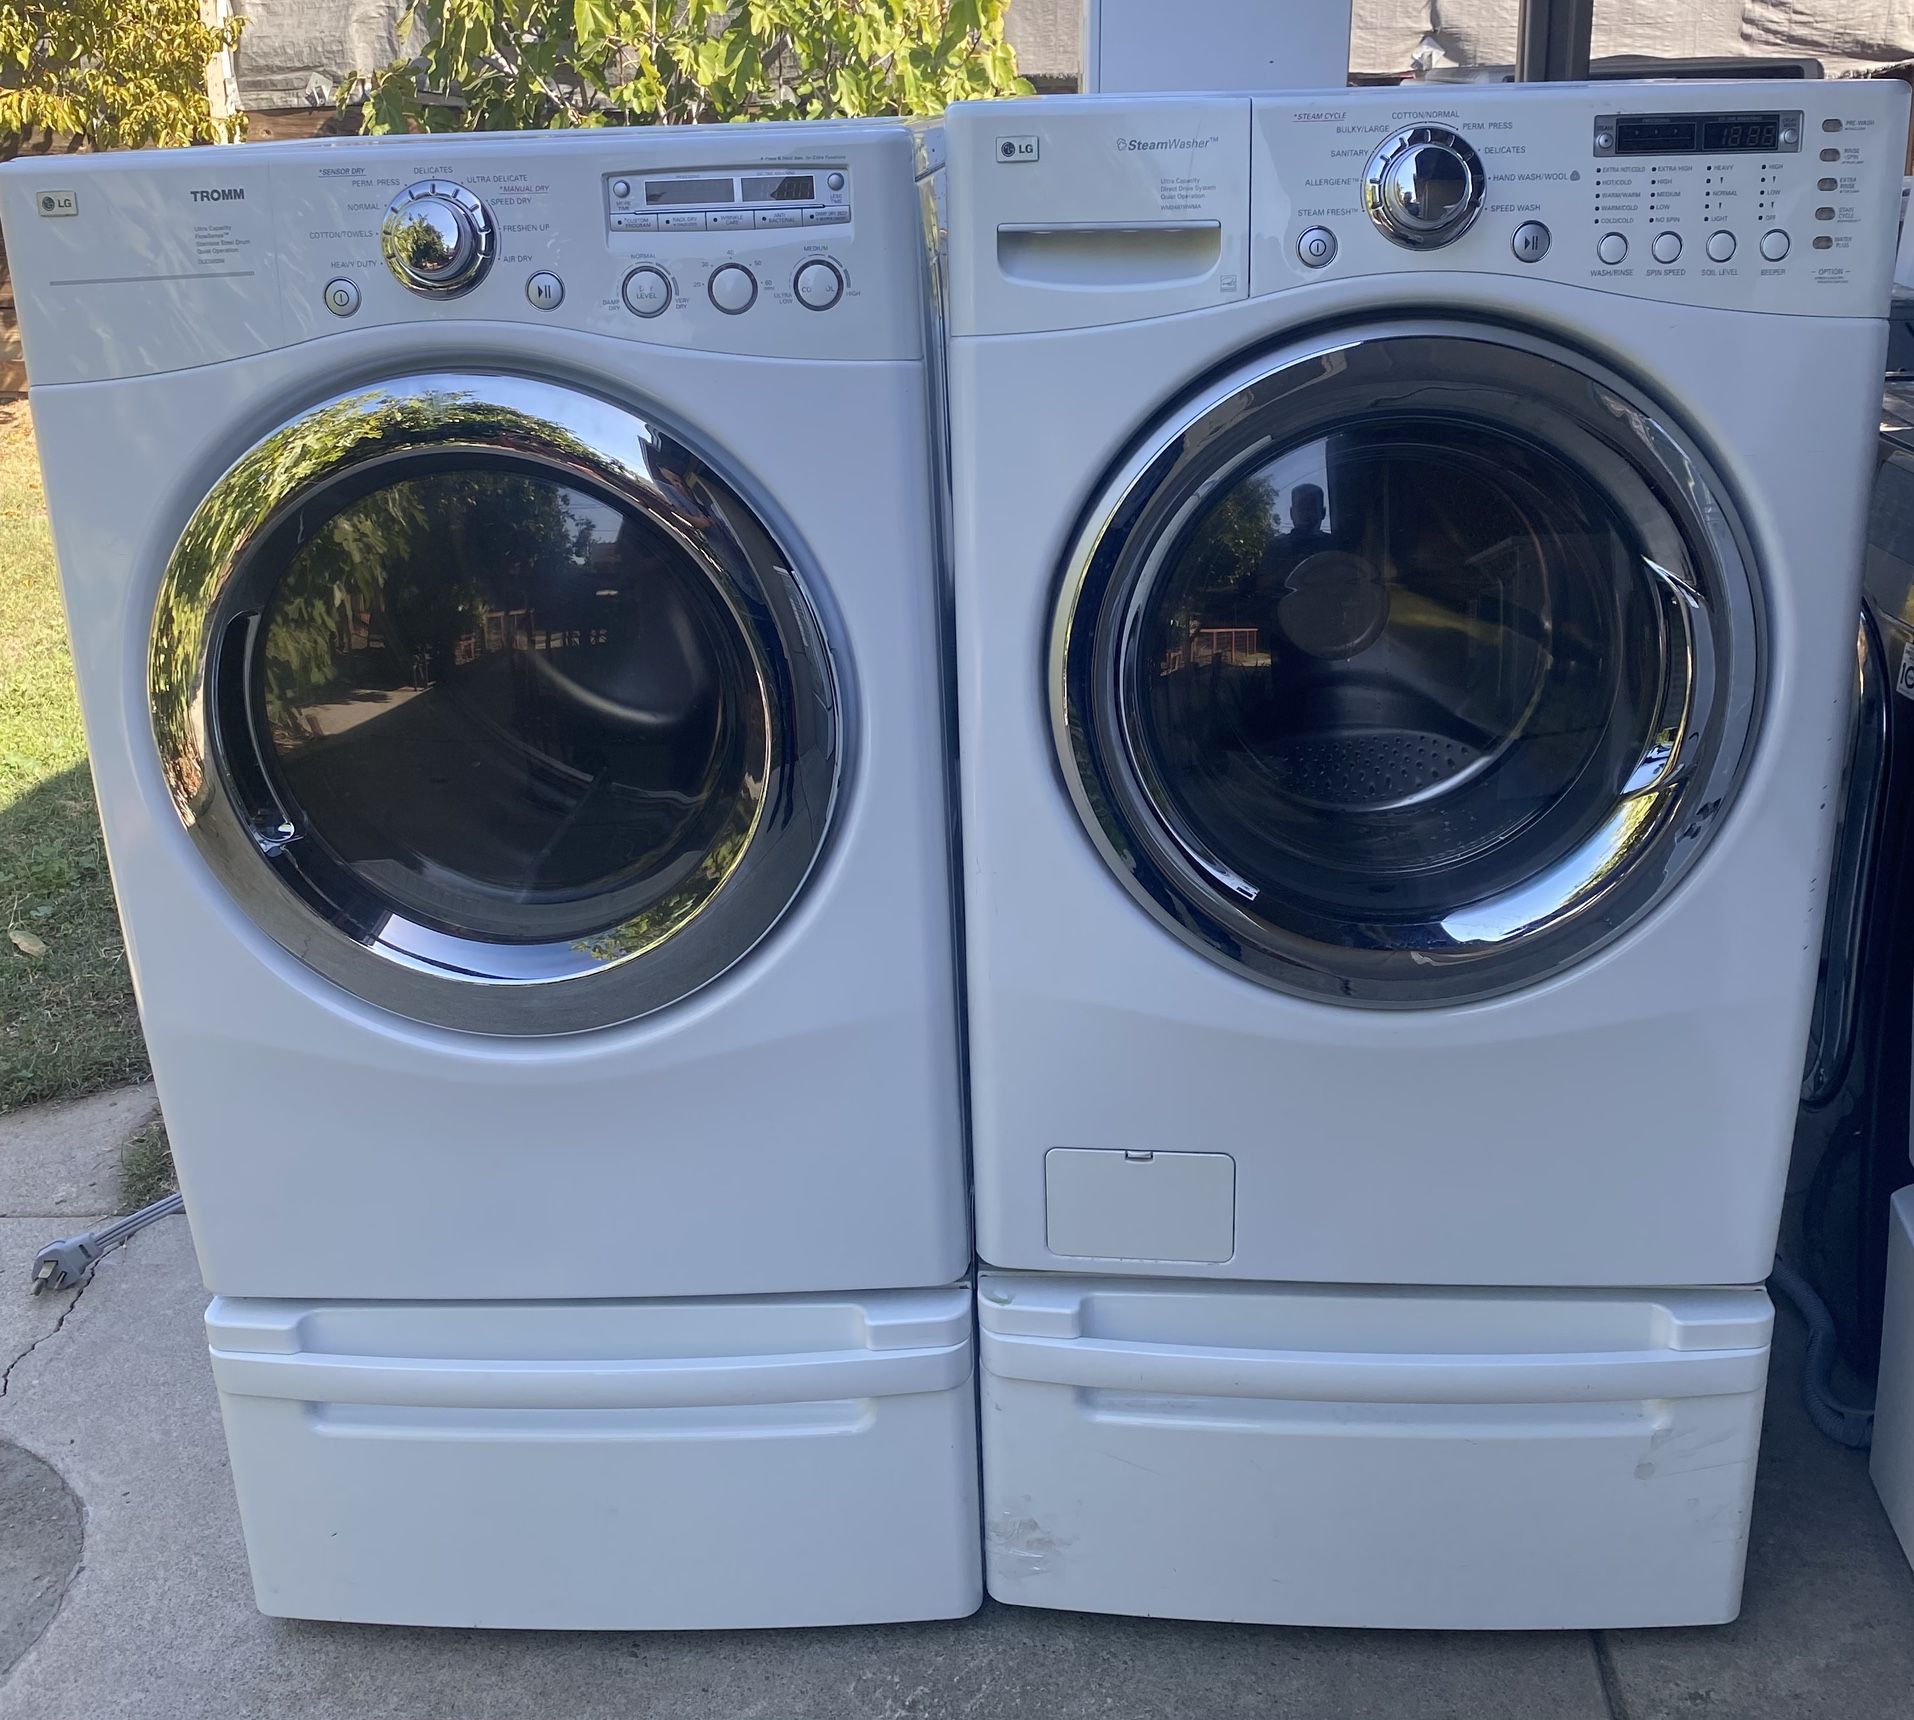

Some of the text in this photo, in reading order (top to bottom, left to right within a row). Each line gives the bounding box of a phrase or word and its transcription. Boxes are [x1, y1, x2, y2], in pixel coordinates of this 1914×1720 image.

[1324, 111, 1347, 120] CYCLE
[1391, 110, 1460, 120] COTTON/NORMAL
[1336, 124, 1390, 134] BULKY/LARGE
[1487, 121, 1514, 130] PRESS
[1128, 136, 1219, 151] SteamWasher™
[1018, 143, 1034, 154] LG
[1484, 146, 1526, 154] DELICATES
[1330, 149, 1369, 158] SANITARY
[351, 167, 366, 175] DRY
[414, 166, 453, 175] DELICATES
[466, 174, 528, 184] ULTRA DELICATE
[1175, 177, 1201, 185] Capacity
[1492, 172, 1568, 182] HAND WASH/WOOL
[376, 178, 400, 186] PRESS
[190, 188, 245, 202] TROMM
[1177, 192, 1206, 200] Operation
[1601, 191, 1641, 199] WARM/WARM
[57, 198, 72, 208] LG
[490, 198, 515, 206] SPEED
[347, 203, 380, 211] NORMAL
[1490, 203, 1541, 213] SPEED WASH
[1297, 208, 1325, 217] STEAM
[503, 223, 550, 232] FRESHEN UP
[309, 230, 374, 239] COTTON/TOWELS
[503, 255, 533, 264] AIR DRY
[330, 260, 378, 269] HEAVY DUTY
[1590, 268, 1634, 277] WASH/RINSE
[1646, 267, 1686, 277] SPIN SPEED
[1701, 267, 1739, 276] SOIL LEVEL
[1760, 267, 1786, 277] BEEPER
[1818, 268, 1844, 276] OPTION
[636, 292, 657, 300] LEVEL
